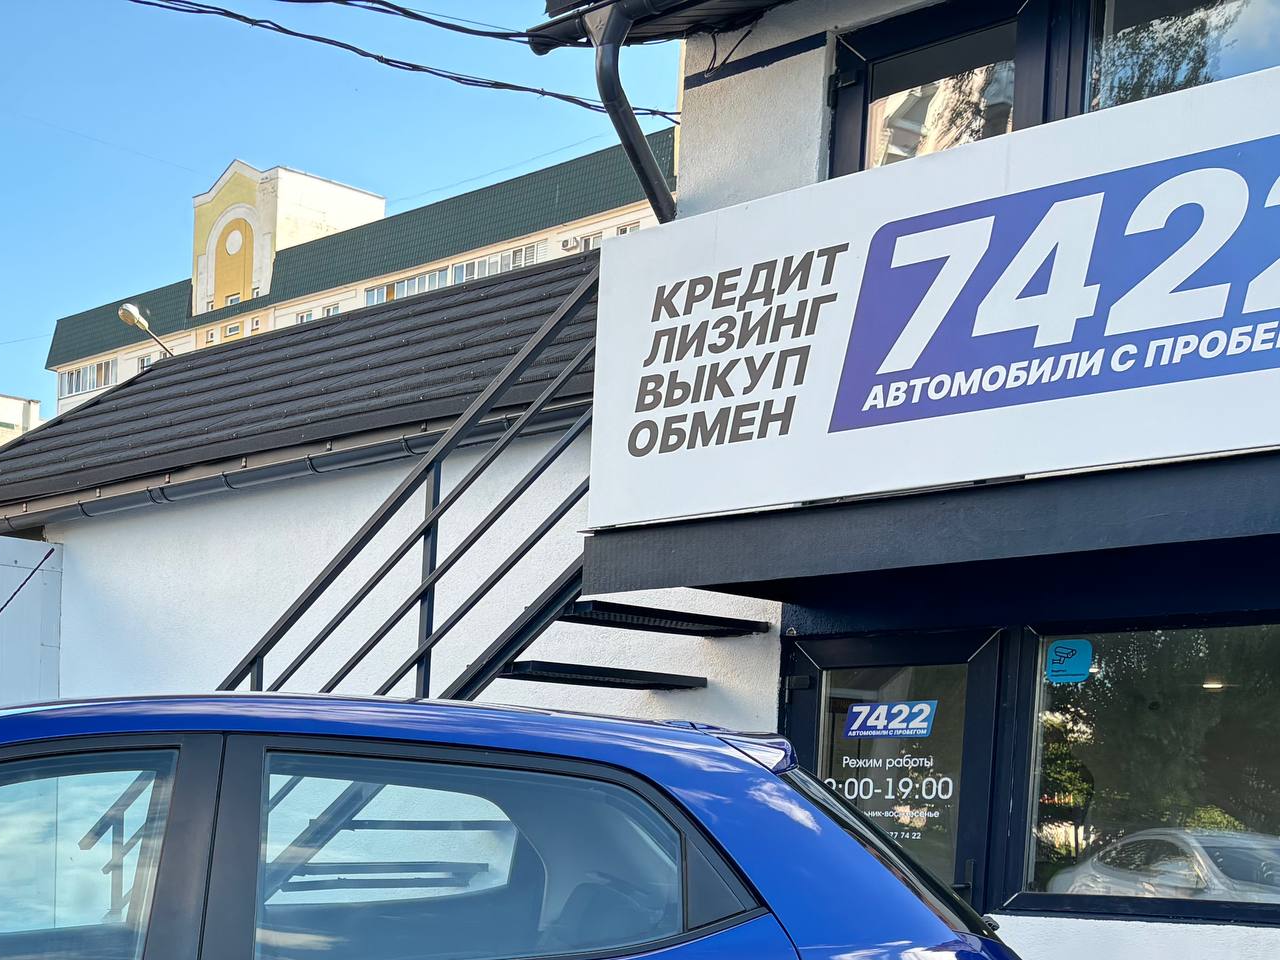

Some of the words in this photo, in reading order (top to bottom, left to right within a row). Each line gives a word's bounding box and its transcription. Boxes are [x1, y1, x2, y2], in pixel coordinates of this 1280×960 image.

[651, 242, 850, 323] КРЕДИТ
[876, 167, 1280, 375] 742
[642, 292, 839, 368] ЛИЗИНГ
[634, 344, 812, 414] ВЫКУП
[861, 348, 1104, 412] АВТОМОБИЛИ
[1109, 344, 1139, 373] С
[1143, 320, 1280, 369] ПРОБЕ
[626, 395, 797, 458] ОБМЕН
[850, 703, 932, 731] 7422
[842, 756, 883, 768] Режим
[886, 754, 933, 770] работы
[911, 832, 922, 840] 22
